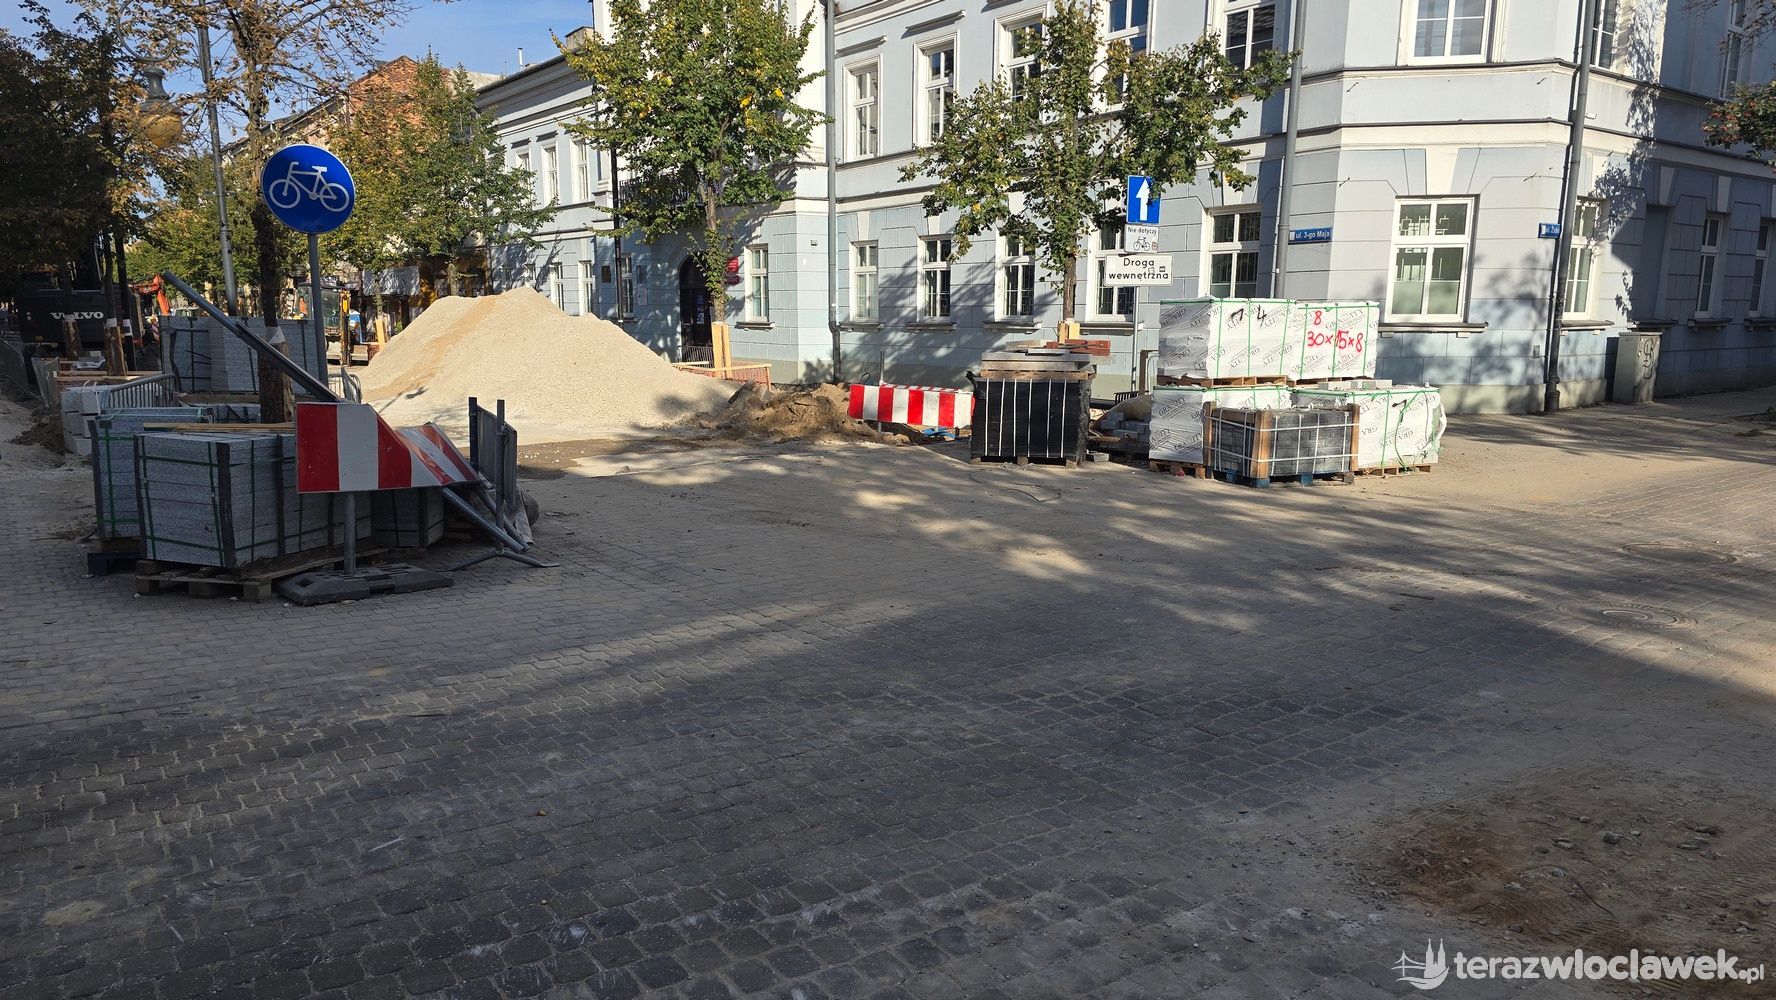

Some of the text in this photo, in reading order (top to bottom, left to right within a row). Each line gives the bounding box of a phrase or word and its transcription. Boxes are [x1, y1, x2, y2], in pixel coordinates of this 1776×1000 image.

[1127, 226, 1158, 236] Nie dotyczy
[1295, 230, 1330, 240] ul. 3-go Maja
[1123, 258, 1155, 268] Droga
[1108, 271, 1169, 282] wewnętrzna
[1313, 310, 1323, 326] 8
